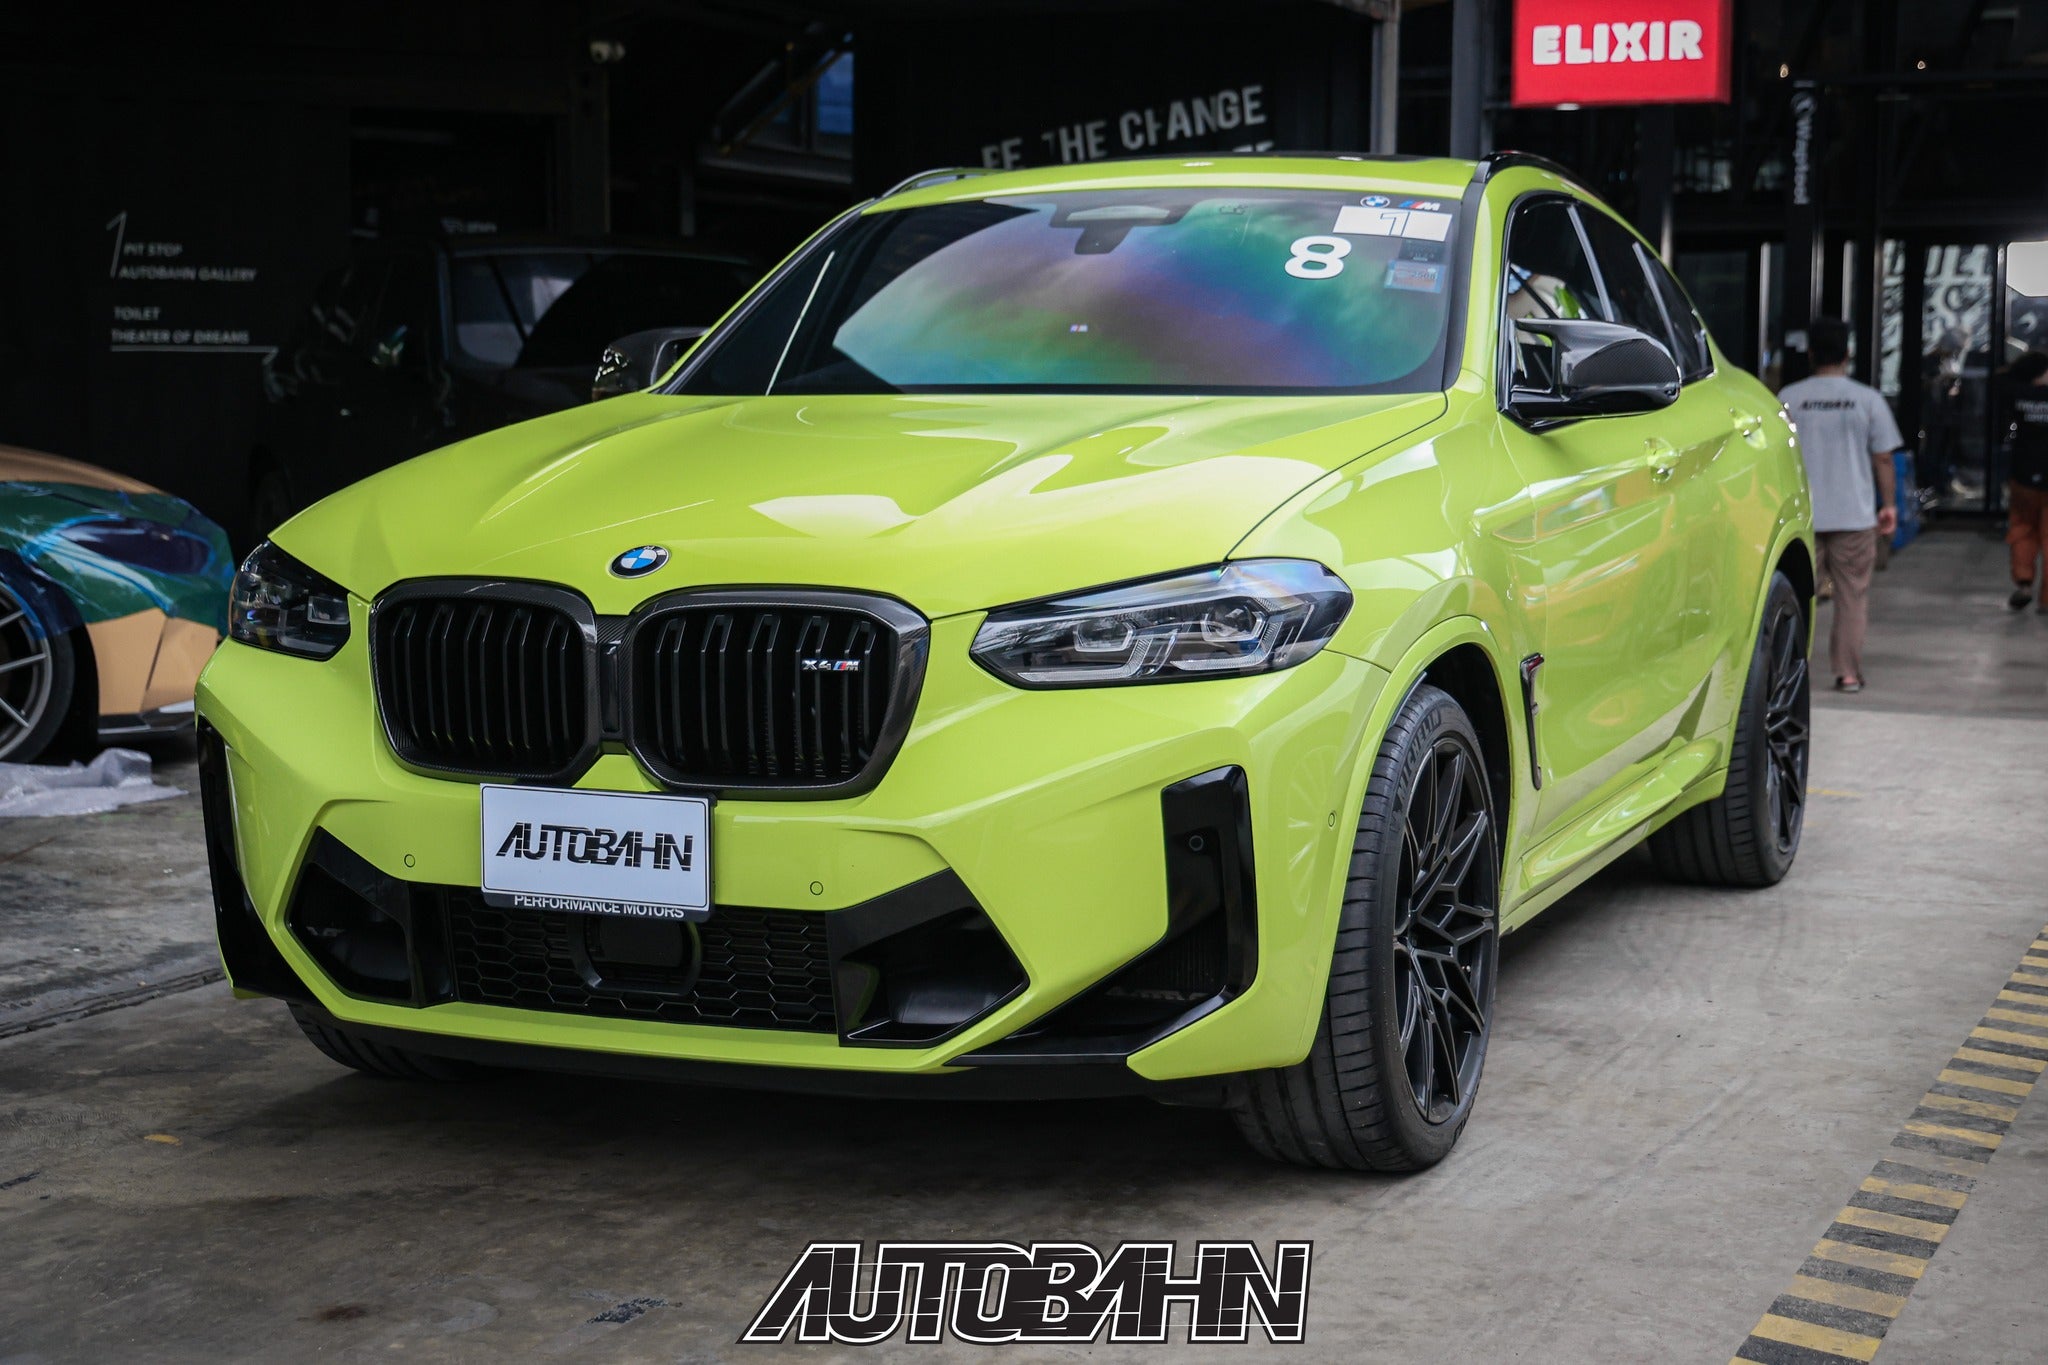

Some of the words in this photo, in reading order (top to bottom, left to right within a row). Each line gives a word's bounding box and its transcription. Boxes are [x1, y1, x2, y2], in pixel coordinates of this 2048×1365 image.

[1532, 19, 1704, 66] ELIXIR
[1119, 84, 1267, 151] CHANGE
[123, 242, 145, 257] PIT
[147, 242, 184, 258] STOP
[1284, 235, 1352, 279] 8
[119, 265, 197, 281] AUTOBAHN
[198, 267, 258, 283] GALLERY
[113, 306, 161, 321] TOILET
[110, 328, 171, 344] THEATER
[172, 329, 192, 344] OF
[193, 329, 250, 345] DREAMS
[496, 822, 693, 872] AUTOBAHN
[513, 894, 621, 915] PERFORMANCE
[623, 903, 685, 919] MOTORS
